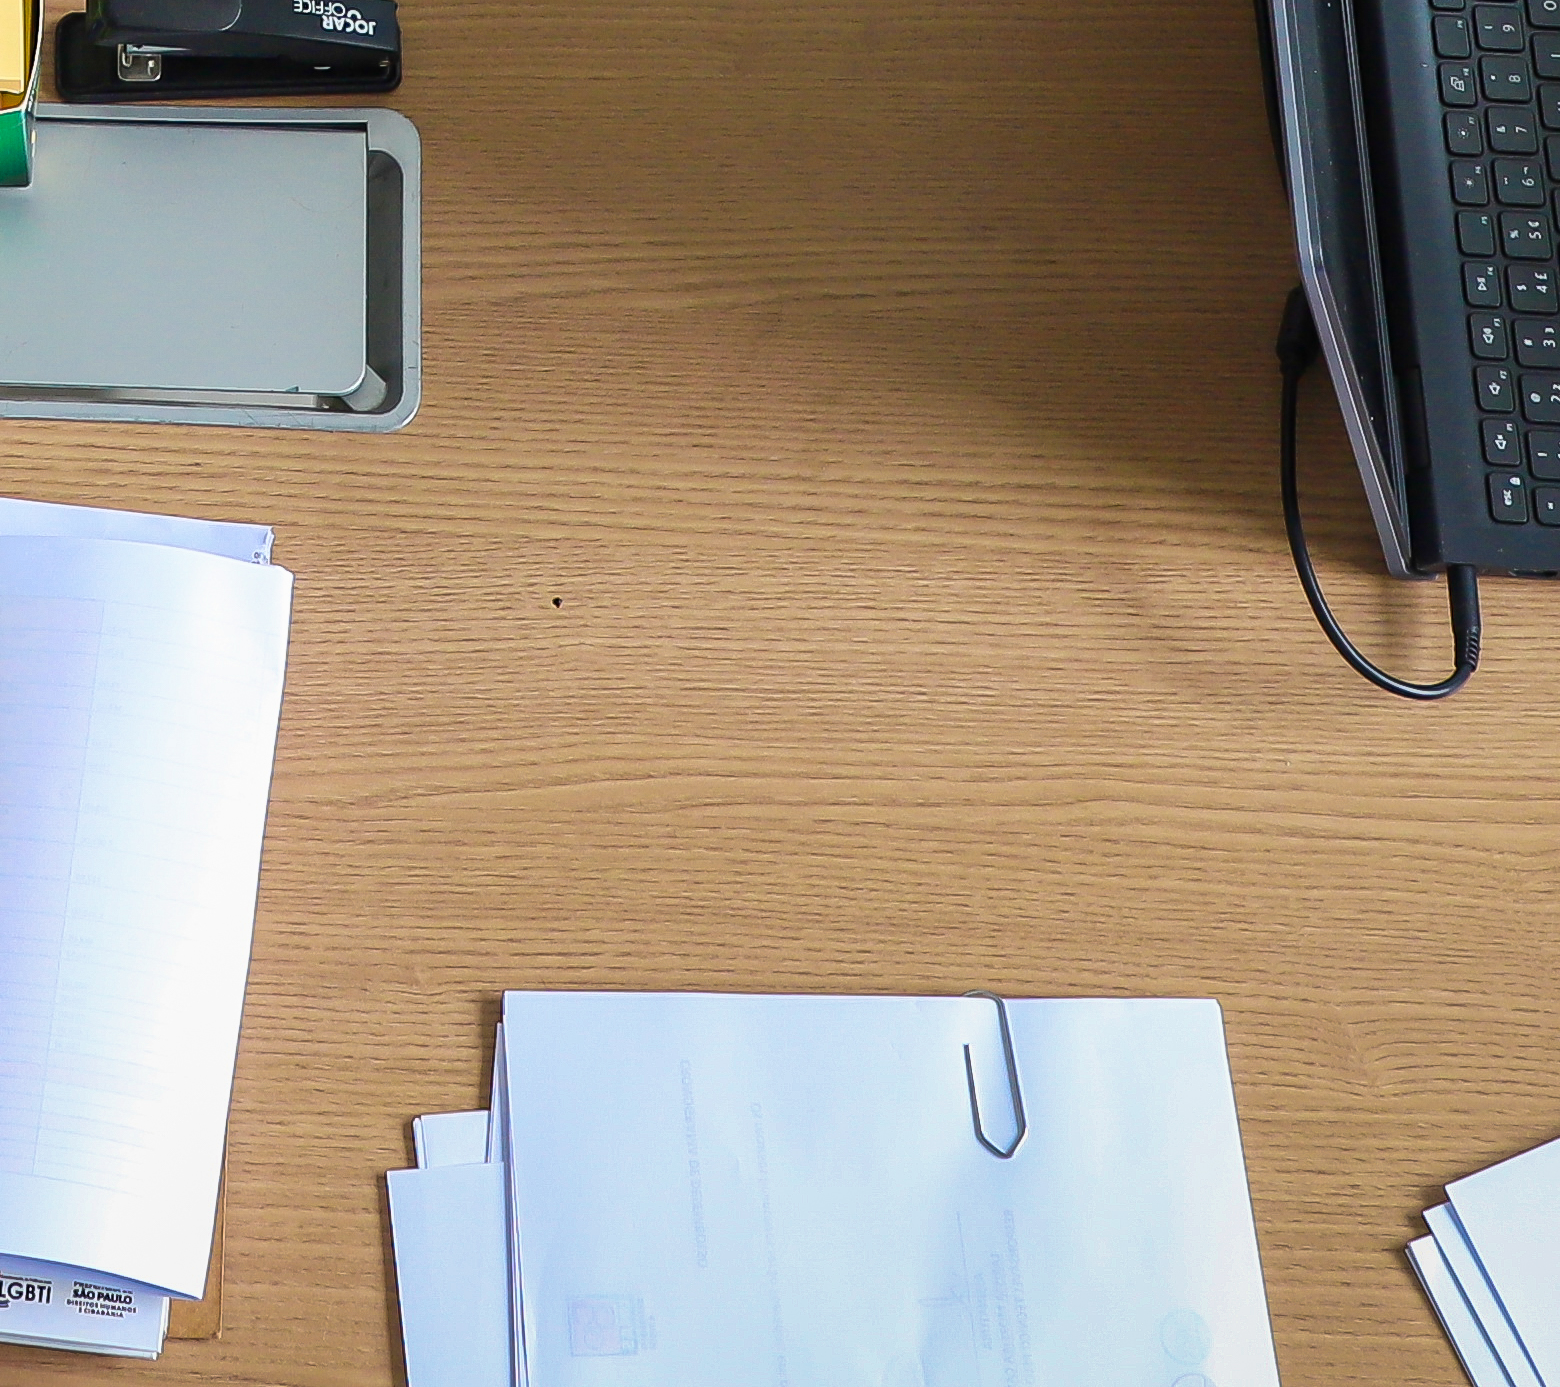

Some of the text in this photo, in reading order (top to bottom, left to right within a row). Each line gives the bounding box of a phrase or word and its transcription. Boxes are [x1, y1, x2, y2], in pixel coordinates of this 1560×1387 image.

[1543, 0, 1557, 11] O
[322, 15, 376, 36] JOCAR
[72, 1286, 95, 1300] SÃO
[97, 1292, 133, 1305] PAULO
